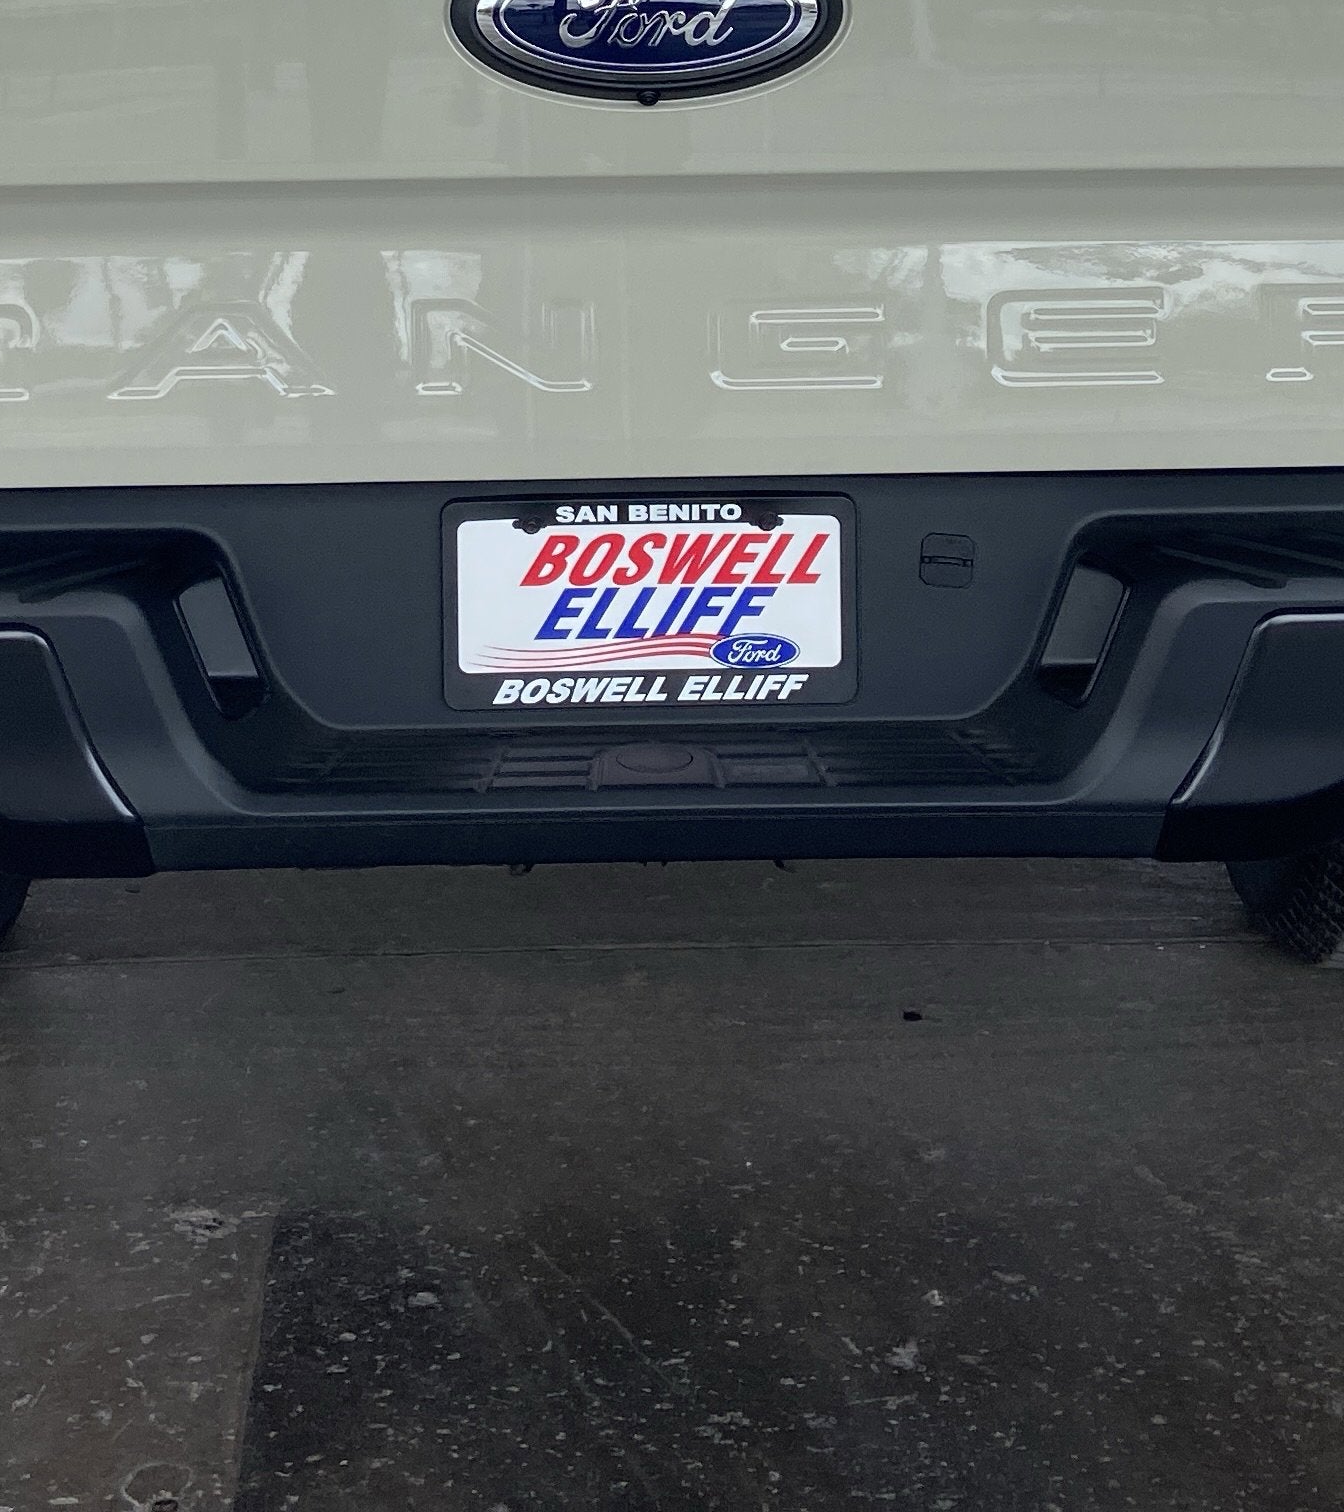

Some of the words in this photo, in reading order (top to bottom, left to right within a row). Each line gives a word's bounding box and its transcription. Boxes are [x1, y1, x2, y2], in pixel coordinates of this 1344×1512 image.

[555, 504, 618, 523] SAN
[628, 503, 742, 522] BENITO
[520, 533, 831, 587] BOSWELL
[534, 586, 779, 641] ELLIFF
[726, 637, 782, 664] Ford
[492, 676, 668, 705] BOSWELL
[677, 674, 810, 702] ELLIFF
